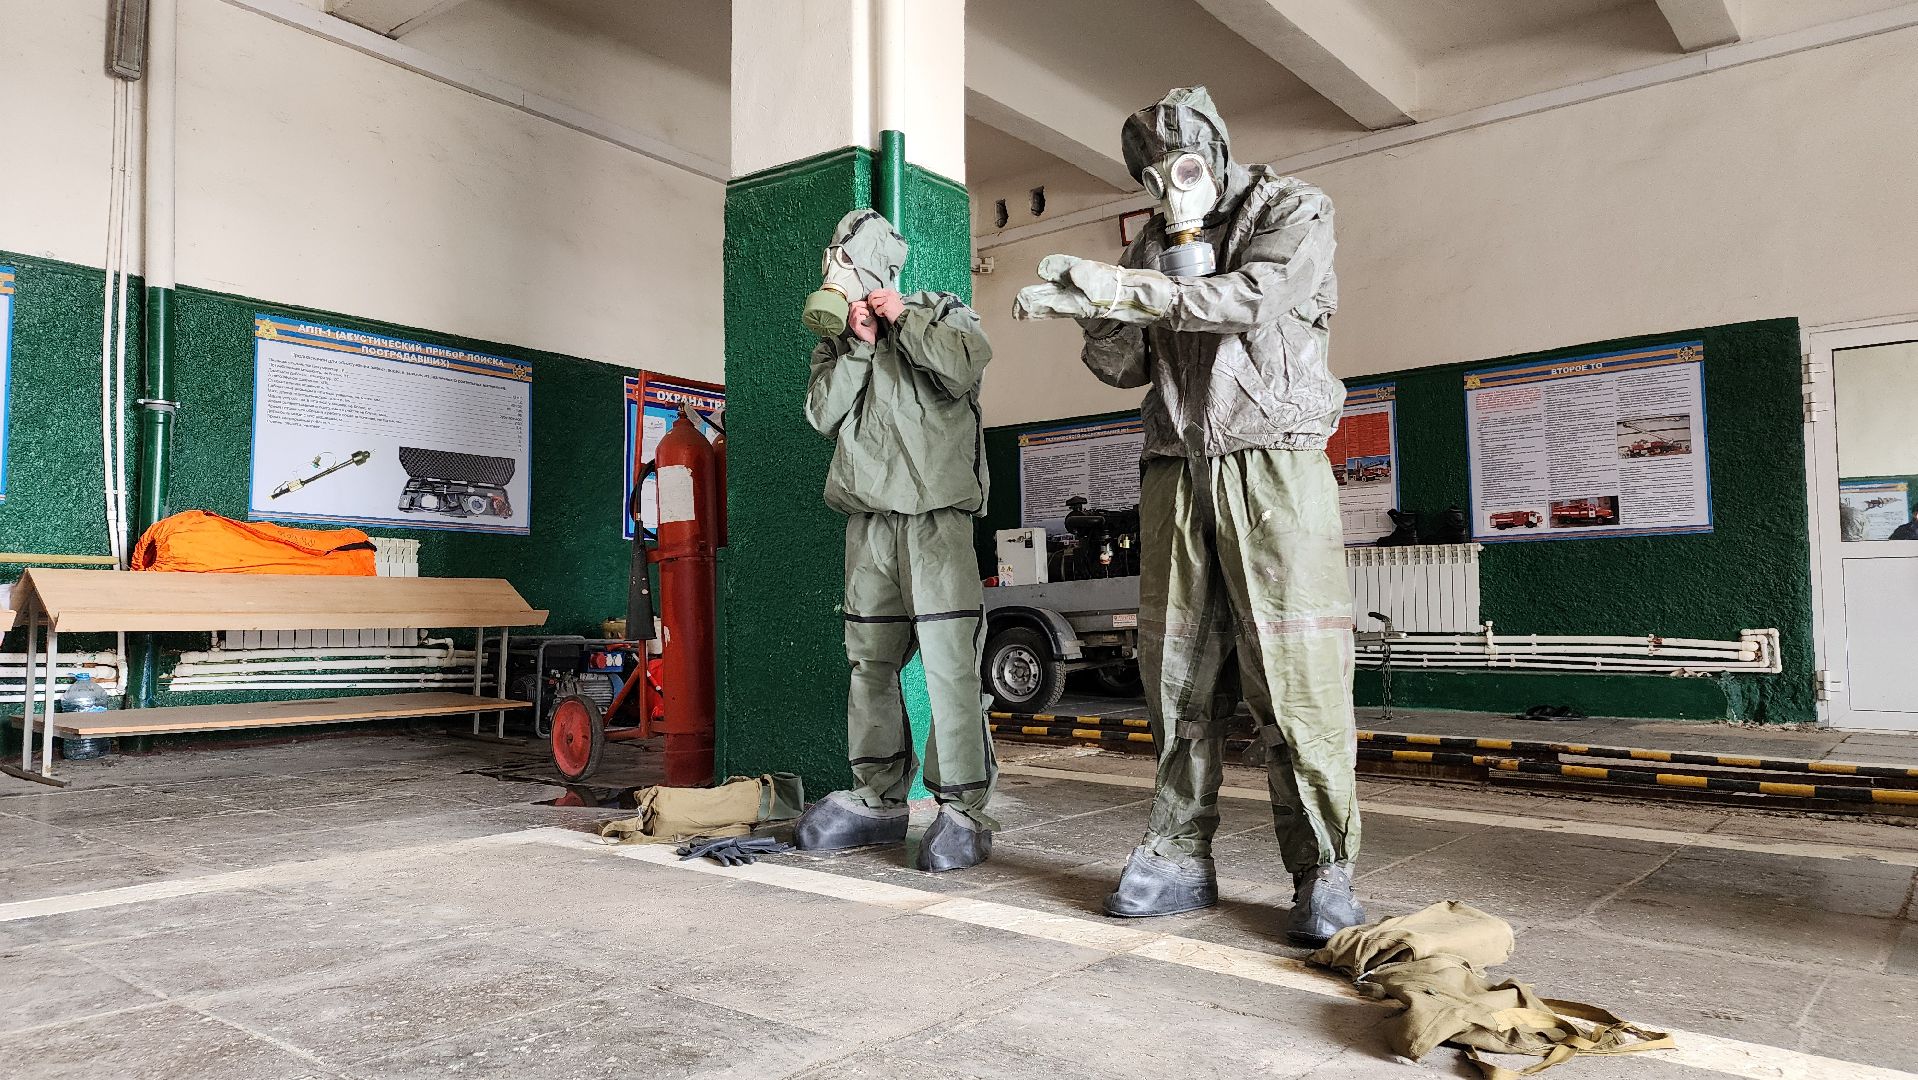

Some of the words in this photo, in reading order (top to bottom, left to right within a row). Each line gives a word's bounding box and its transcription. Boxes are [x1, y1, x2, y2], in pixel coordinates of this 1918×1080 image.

[425, 346, 465, 359] ПРИБОР
[467, 353, 505, 367] ПОИСКА
[1551, 364, 1588, 375] ВТОРОЕ
[1590, 362, 1603, 370] ТО
[656, 390, 705, 408] ОХРАНА
